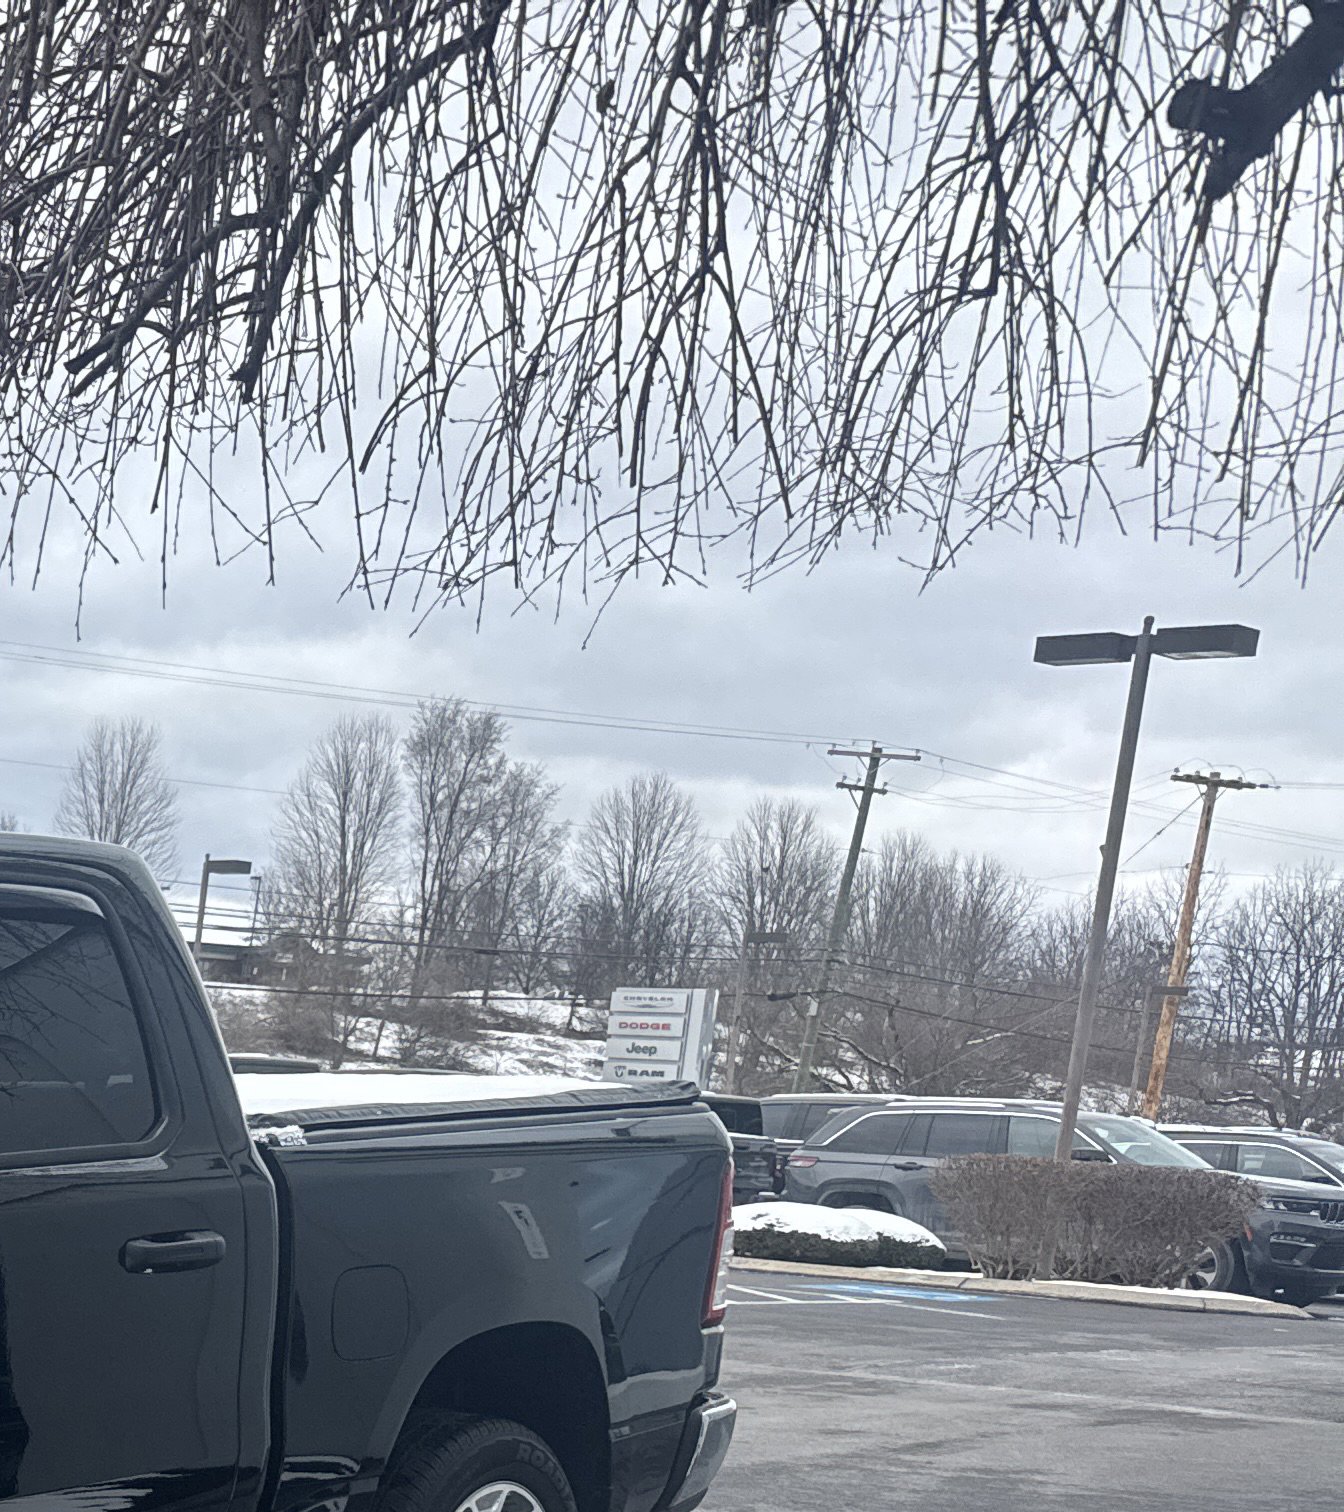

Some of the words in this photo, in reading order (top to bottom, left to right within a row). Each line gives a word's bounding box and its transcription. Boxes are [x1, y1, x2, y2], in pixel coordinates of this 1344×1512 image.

[618, 1022, 671, 1031] DODGE
[626, 1042, 657, 1057] Jeep
[627, 1069, 665, 1078] RAM
